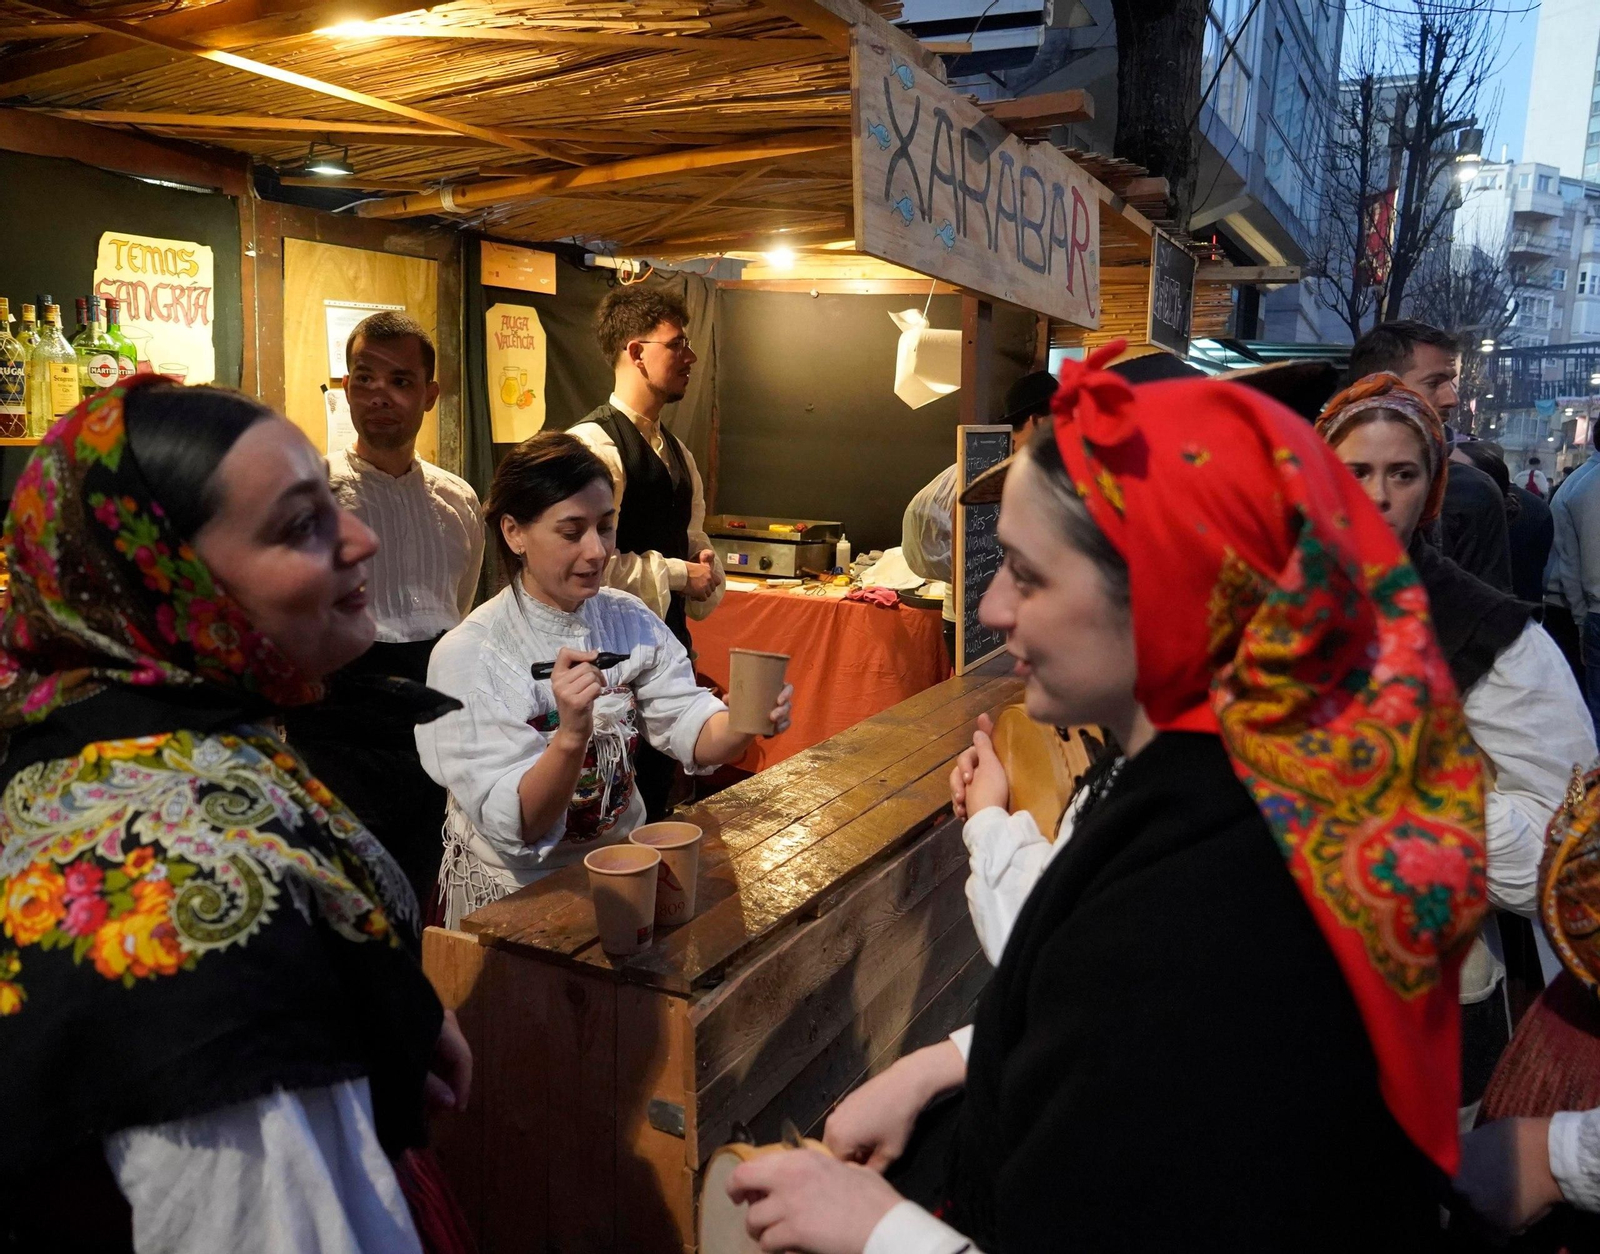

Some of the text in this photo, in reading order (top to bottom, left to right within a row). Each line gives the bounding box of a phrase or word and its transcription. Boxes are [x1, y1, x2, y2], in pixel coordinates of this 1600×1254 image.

[883, 76, 1095, 319] XARABAR
[108, 238, 200, 278] TEMOS
[95, 277, 212, 329] SANGRÍA
[501, 314, 530, 331] AUGA
[90, 366, 117, 375] MARTINI
